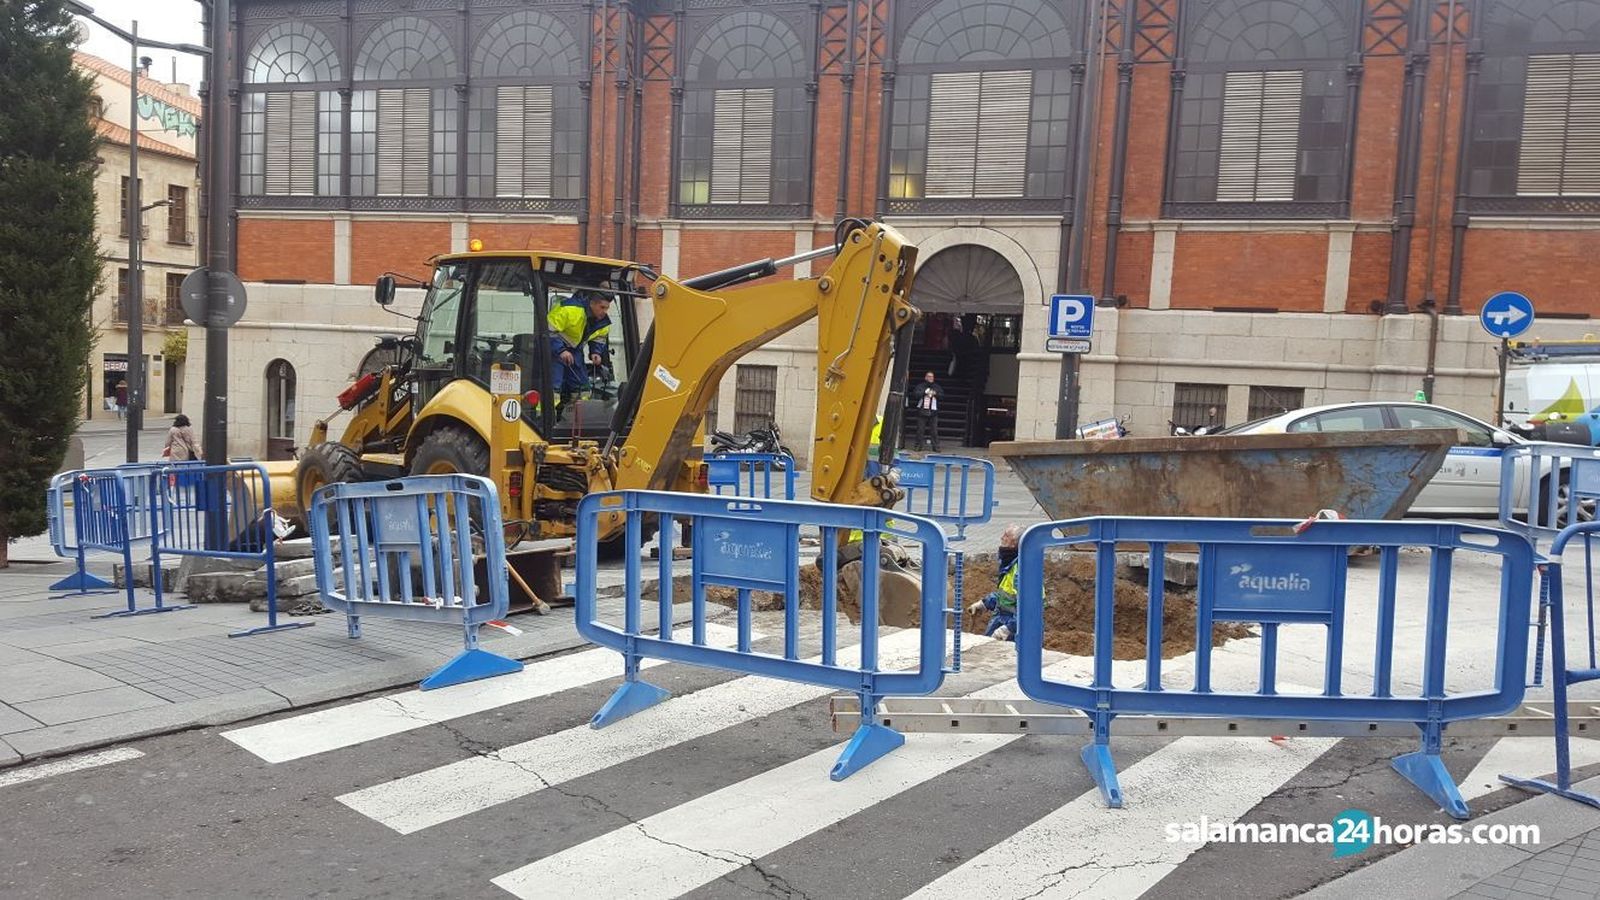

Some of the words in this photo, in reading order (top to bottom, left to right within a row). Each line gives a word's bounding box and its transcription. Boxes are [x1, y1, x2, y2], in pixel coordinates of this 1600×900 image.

[1057, 299, 1085, 333] P
[506, 401, 517, 419] 40
[1238, 573, 1311, 593] aqualia
